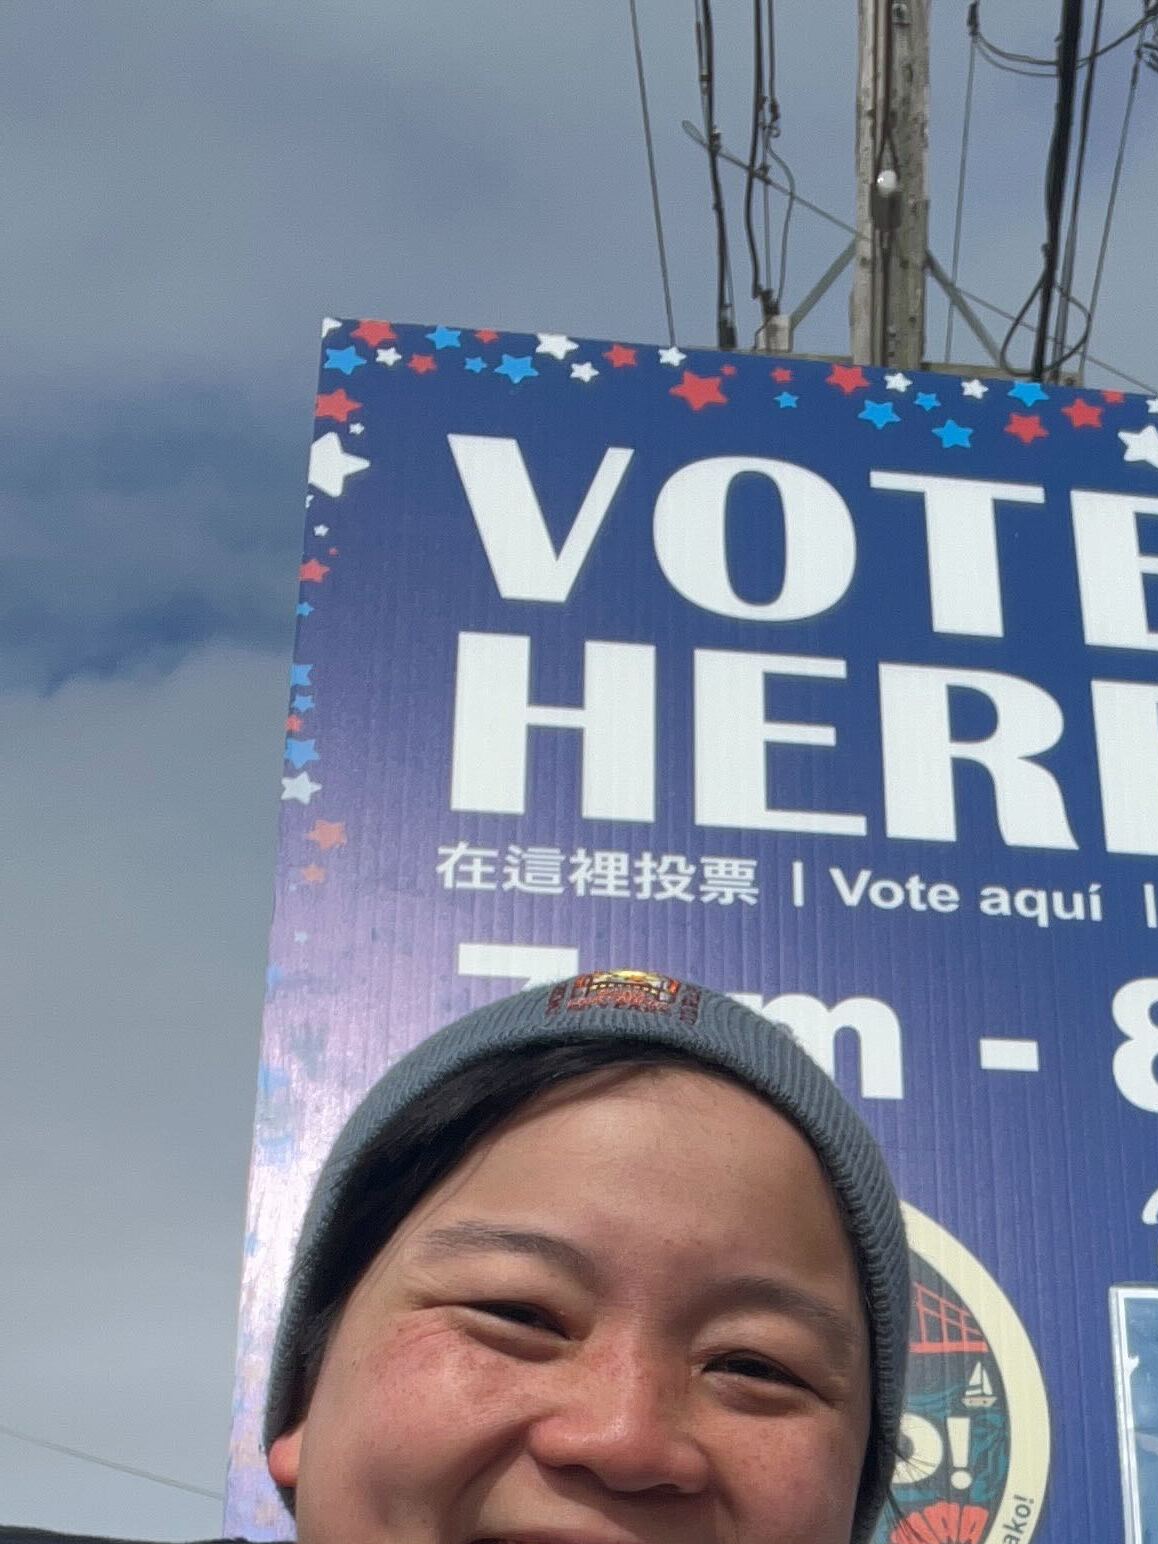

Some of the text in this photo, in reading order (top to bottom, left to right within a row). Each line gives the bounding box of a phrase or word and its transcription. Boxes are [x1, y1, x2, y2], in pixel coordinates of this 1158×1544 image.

[436, 840, 760, 907] 在這裡投票
[830, 868, 1102, 927] Vote aquí
